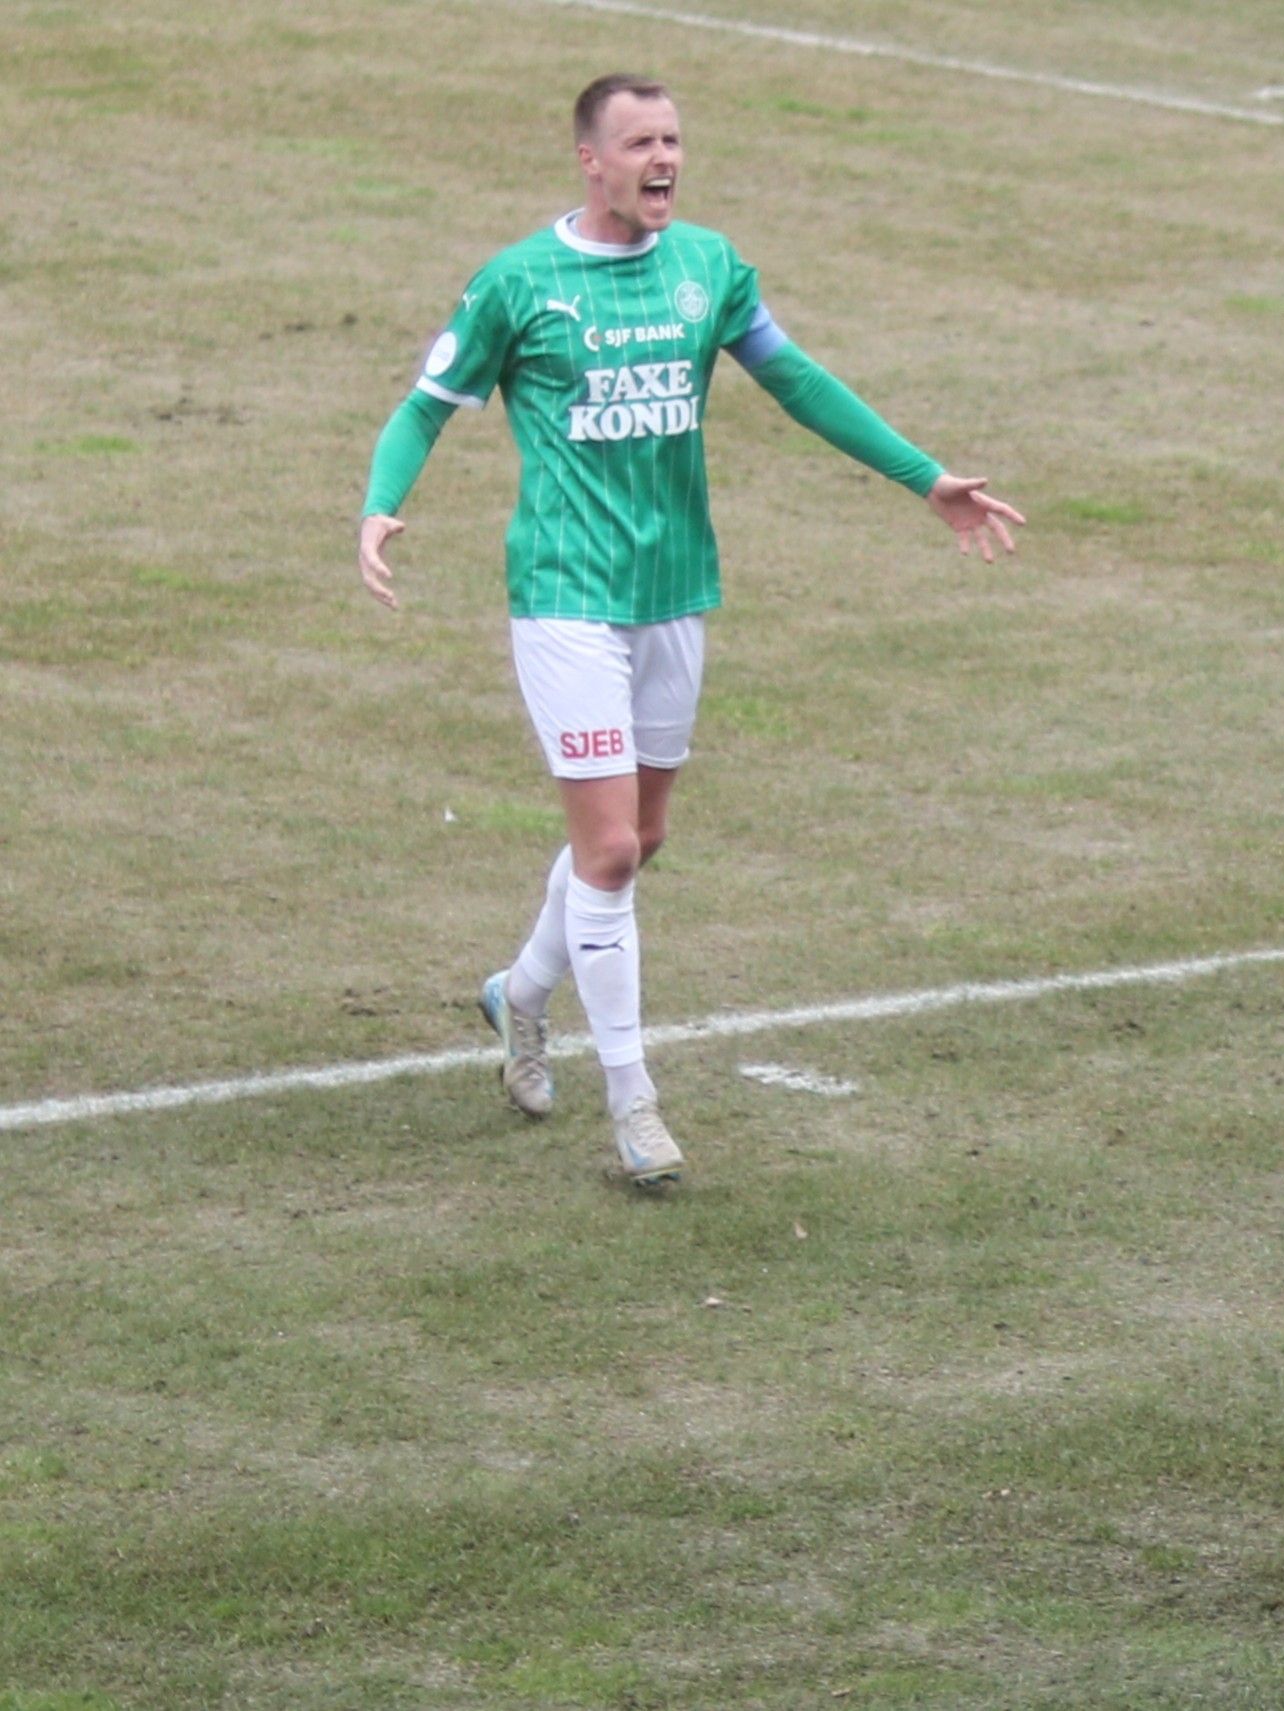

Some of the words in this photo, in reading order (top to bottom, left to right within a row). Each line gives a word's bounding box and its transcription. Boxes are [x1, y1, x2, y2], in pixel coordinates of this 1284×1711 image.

[604, 327, 632, 349] SJF
[634, 322, 686, 343] BANK
[584, 360, 693, 403] FAXE
[567, 396, 700, 442] KONDI
[559, 728, 625, 760] SJEB
